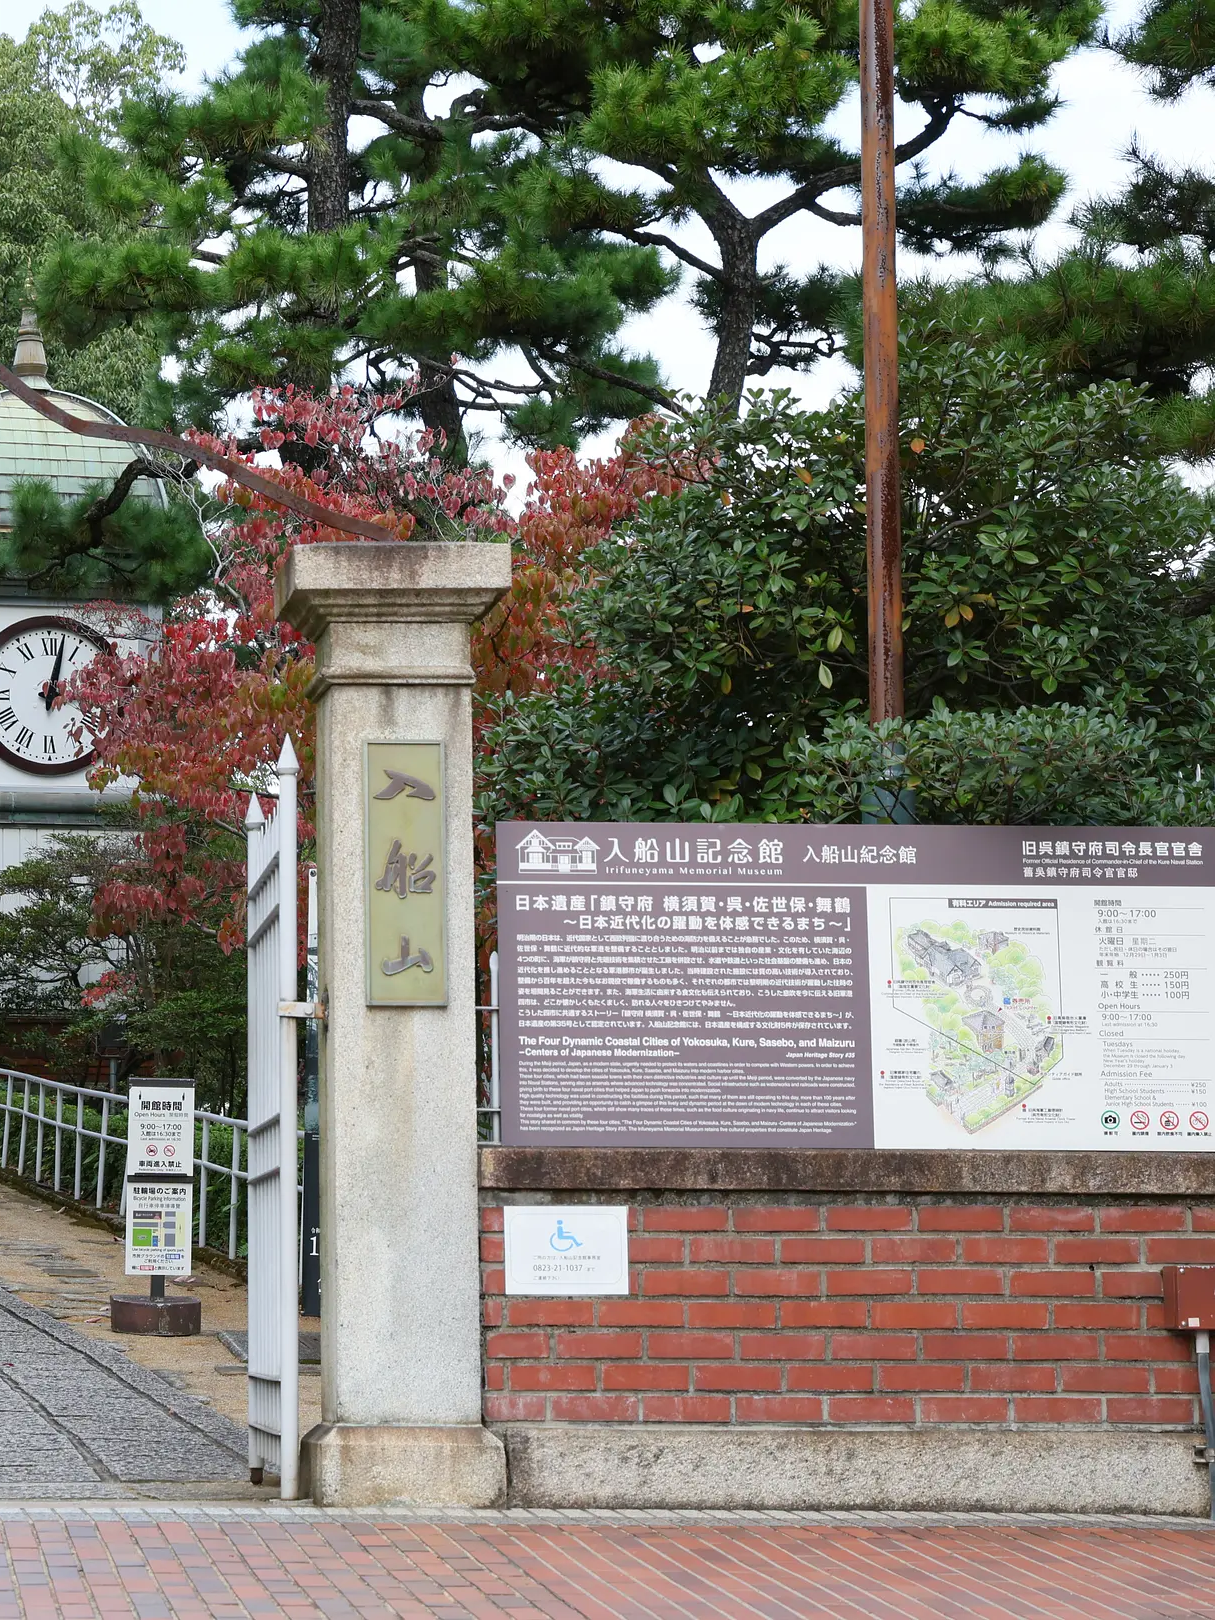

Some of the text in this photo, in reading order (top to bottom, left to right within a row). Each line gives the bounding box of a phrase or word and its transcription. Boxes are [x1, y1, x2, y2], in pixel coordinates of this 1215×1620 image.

[603, 837, 783, 864] 入船山記念館
[1022, 840, 1203, 857] 旧呉鎮守府司令長官官舎
[373, 768, 436, 976] 入船山
[605, 866, 783, 876] Irifuneyama Memorial Museum
[1099, 937, 1124, 945] 火曜日
[1163, 971, 1189, 979] 250円
[1100, 981, 1190, 989] 高校生 150円
[1165, 991, 1190, 999] 100円
[519, 1036, 855, 1048] The Four Dynamic Coastal Cities of Yokosuka, Kure, Sasebo, and Maizuru
[560, 1048, 569, 1057] of
[571, 1048, 612, 1057] Japanese
[141, 1101, 182, 1111] 開館時間
[133, 1187, 186, 1195] 駐輪場のご案内
[533, 1264, 583, 1272] 0823-21-1037
